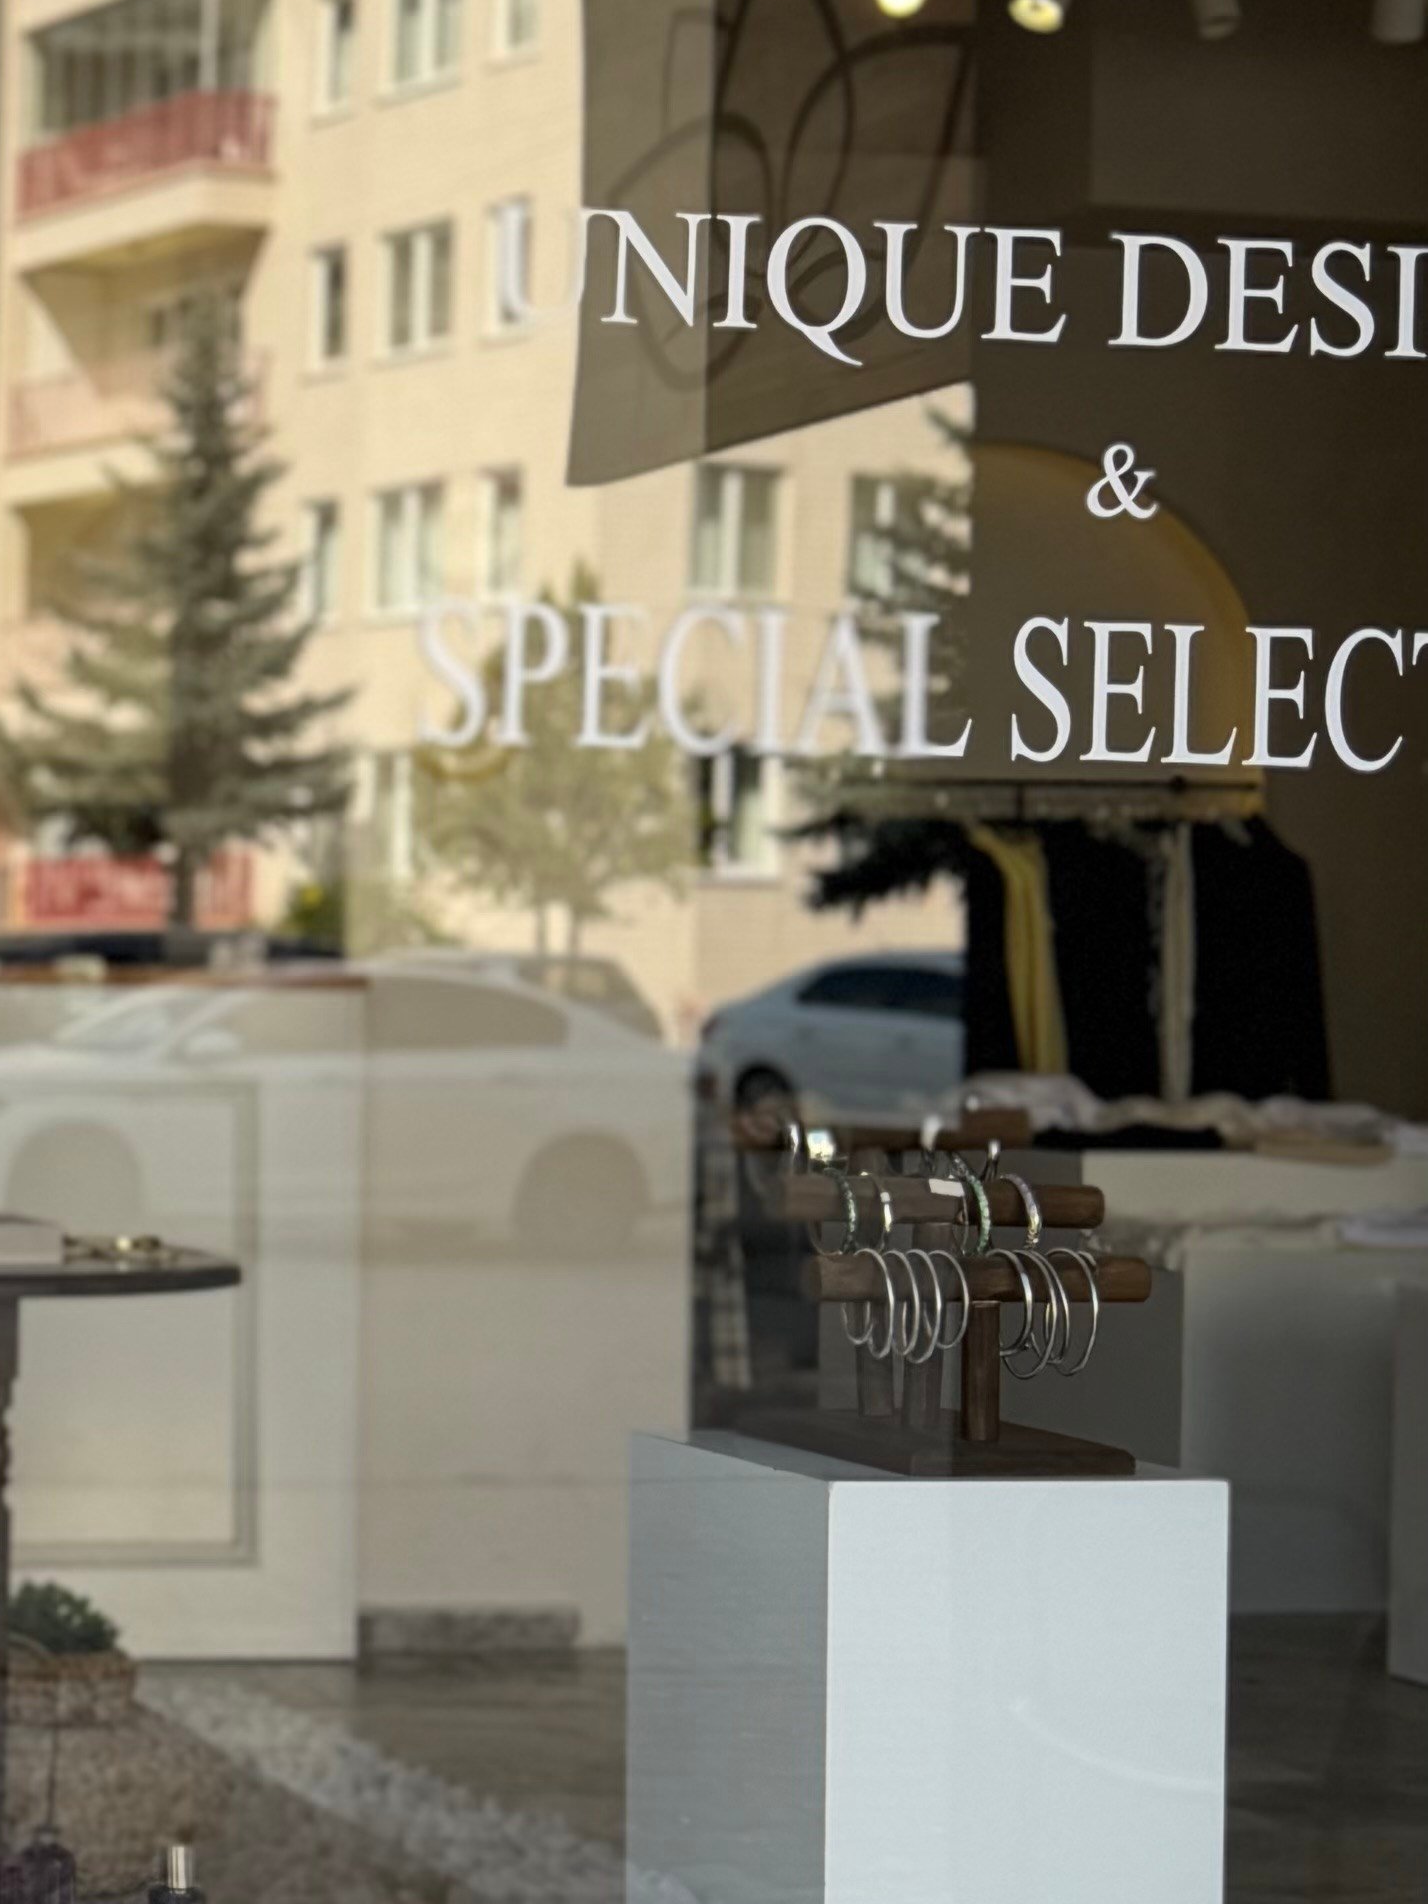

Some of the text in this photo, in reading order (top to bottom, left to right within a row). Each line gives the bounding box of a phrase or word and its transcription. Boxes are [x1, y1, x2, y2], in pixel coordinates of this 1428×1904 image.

[1107, 232, 1428, 359] DESI
[1085, 442, 1158, 519] &
[416, 598, 1428, 773] SPECIAL SELEC
